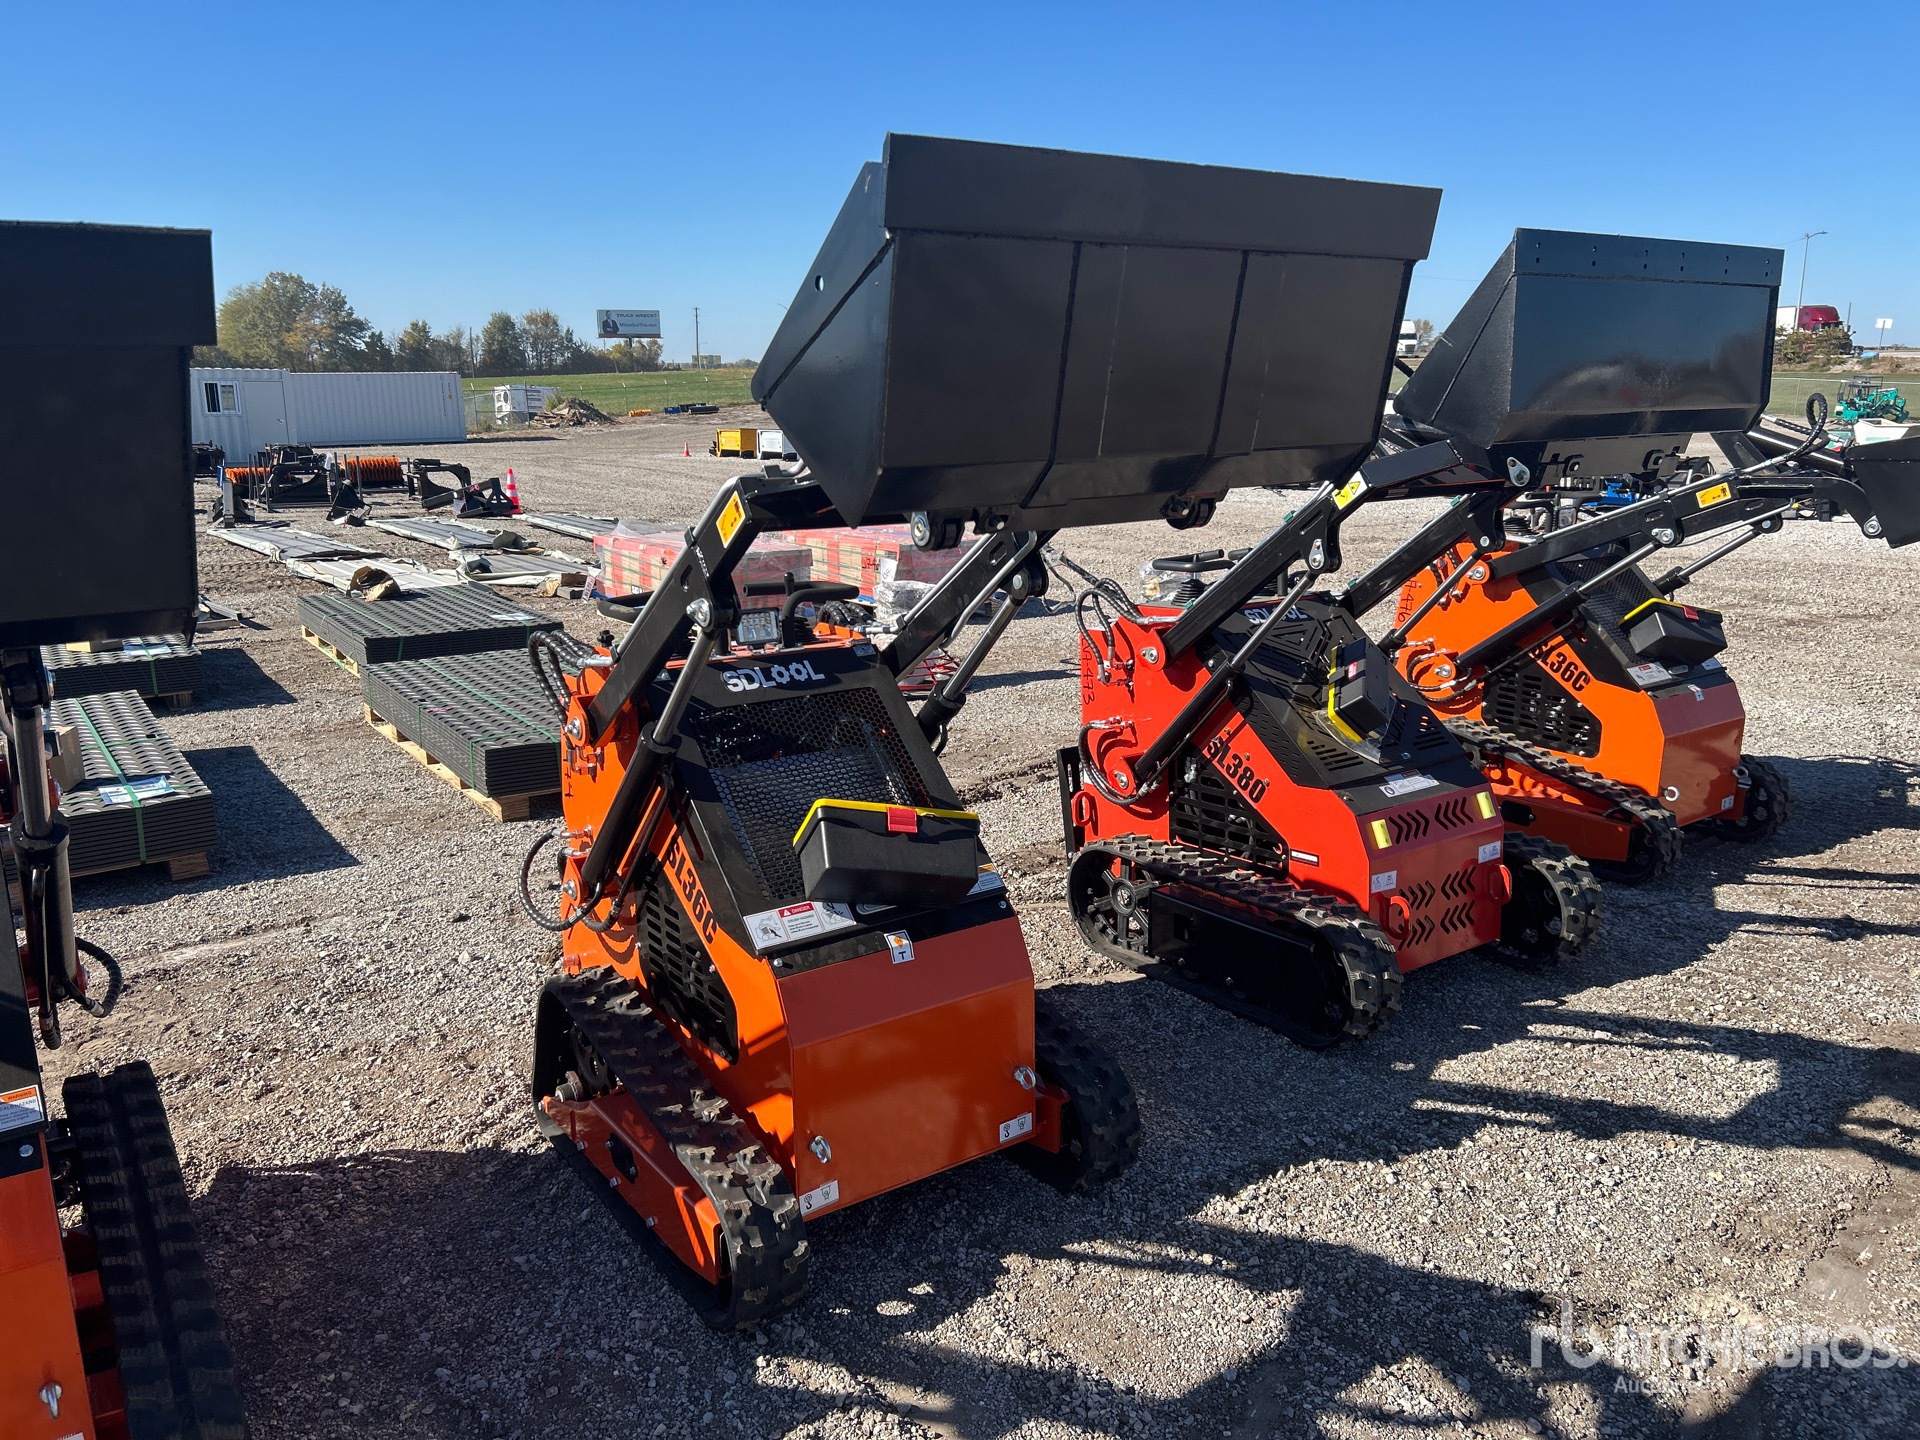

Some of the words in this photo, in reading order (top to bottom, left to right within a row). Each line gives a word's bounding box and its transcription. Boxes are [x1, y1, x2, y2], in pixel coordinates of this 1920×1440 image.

[1244, 608, 1308, 625] SDLOL
[722, 660, 825, 692] SDLOOL
[1206, 736, 1267, 803] SL380
[665, 837, 718, 945] SL36C
[791, 905, 811, 914] DANGER
[898, 951, 906, 960] T
[7, 1090, 32, 1100] WARNING
